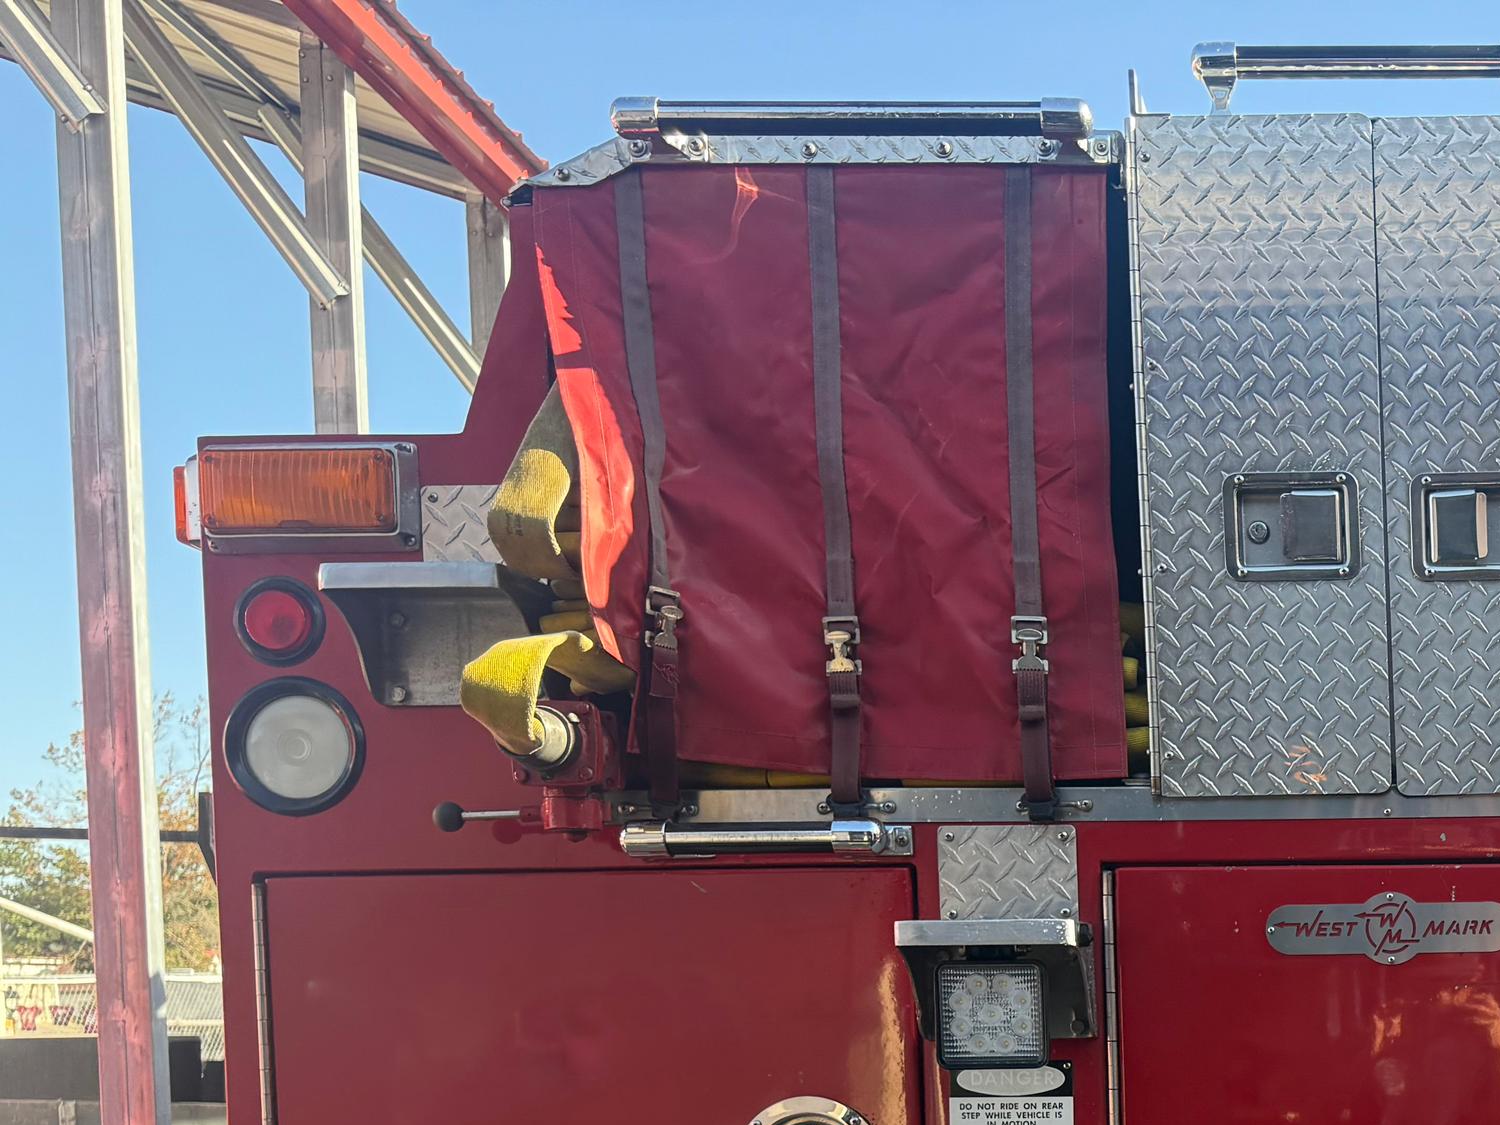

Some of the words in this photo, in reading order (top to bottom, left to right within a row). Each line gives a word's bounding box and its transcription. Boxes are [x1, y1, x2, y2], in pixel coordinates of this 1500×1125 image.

[1293, 910, 1358, 938] WEST
[1422, 919, 1494, 938] MARK
[971, 1070, 1054, 1086] DANGER
[959, 1103, 972, 1111] DO
[1023, 1102, 1037, 1110] ON
[1041, 1102, 1064, 1110] REAR
[961, 1112, 981, 1120] STEP
[1016, 1111, 1050, 1119] VEHICLE
